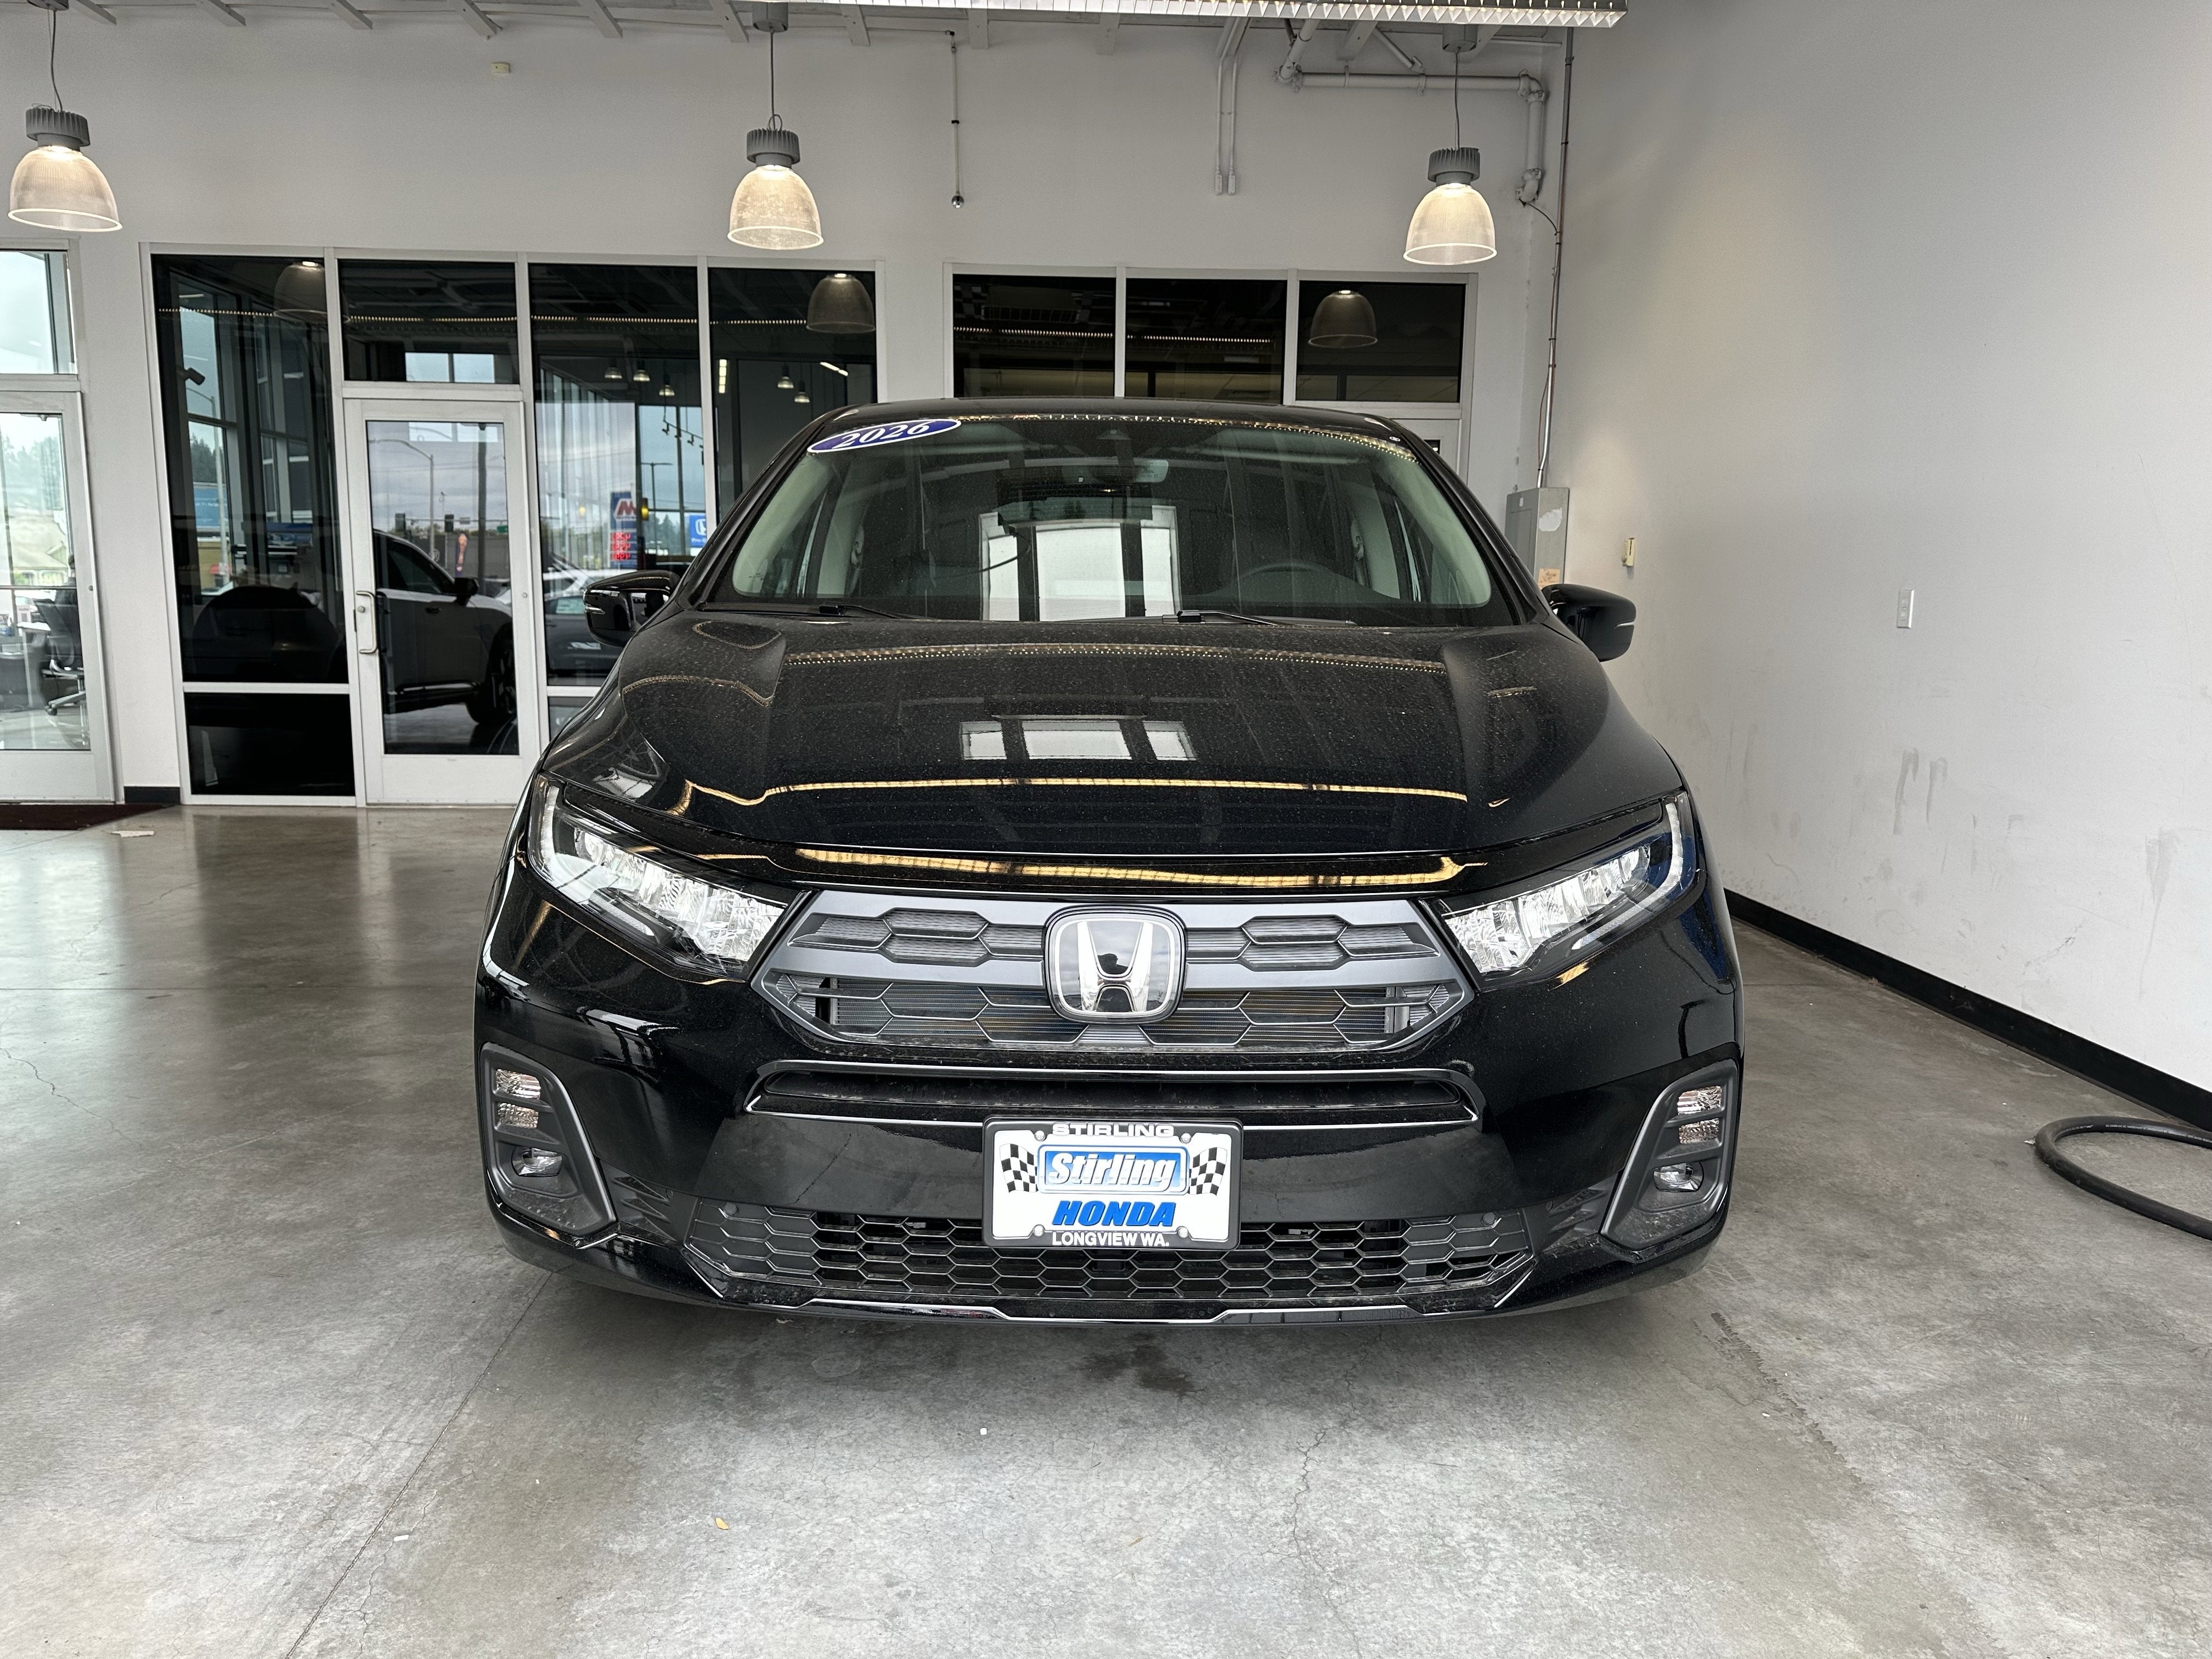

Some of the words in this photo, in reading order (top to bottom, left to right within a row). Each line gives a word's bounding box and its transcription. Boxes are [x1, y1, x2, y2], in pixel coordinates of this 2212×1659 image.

[832, 421, 936, 449] 2026
[1052, 1122, 1174, 1137] STIRLING
[1049, 1153, 1177, 1192] Stirling
[1052, 1200, 1176, 1226] HONDA
[1052, 1232, 1138, 1246] LONGVIEW
[1141, 1232, 1170, 1246] WA.
